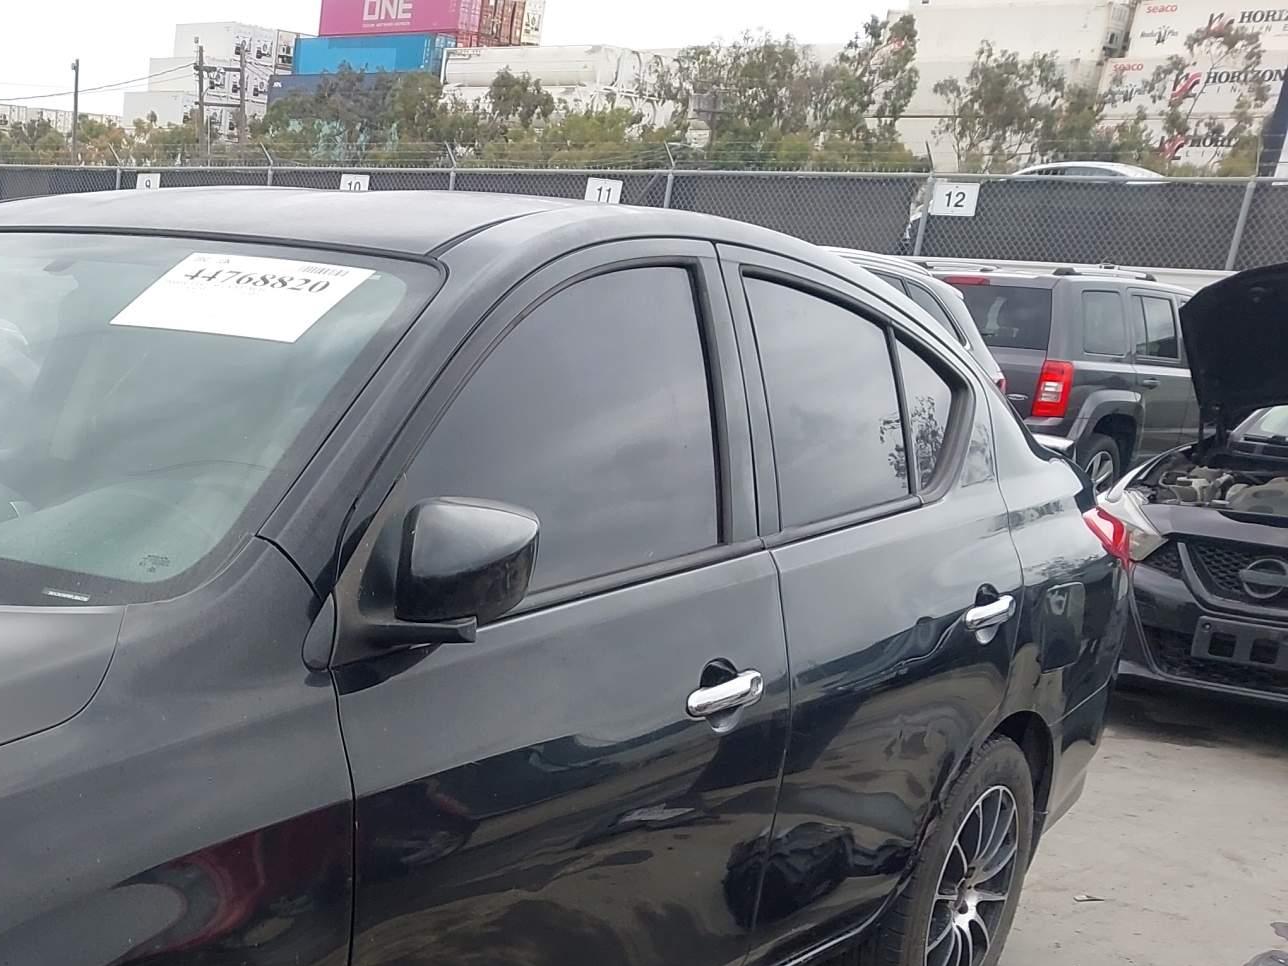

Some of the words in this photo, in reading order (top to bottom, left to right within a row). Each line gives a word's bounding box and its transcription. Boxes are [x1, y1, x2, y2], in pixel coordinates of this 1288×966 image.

[363, 0, 413, 20] ONE
[1145, 4, 1178, 14] seaco
[347, 180, 361, 190] 10
[596, 186, 612, 203] 11
[945, 191, 966, 208] 12
[184, 268, 330, 293] 44768820
